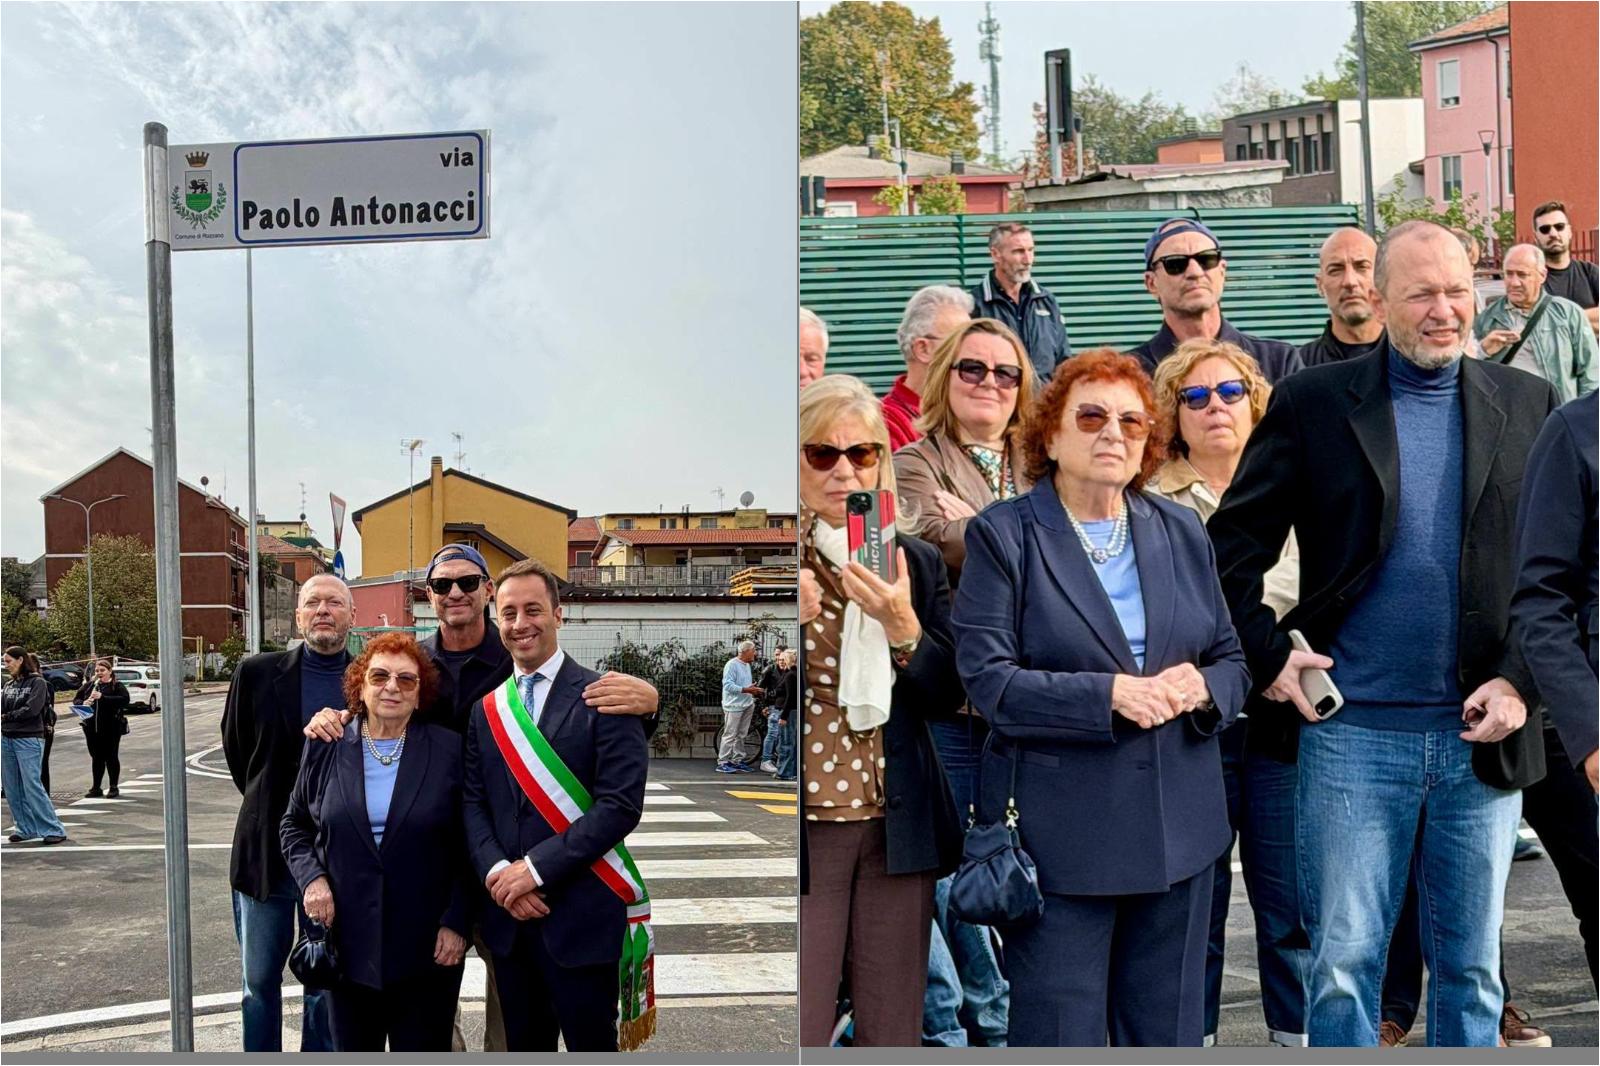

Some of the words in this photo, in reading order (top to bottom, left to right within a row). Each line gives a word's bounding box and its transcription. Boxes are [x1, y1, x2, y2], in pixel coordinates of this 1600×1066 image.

[440, 147, 474, 168] via
[242, 199, 320, 230] Paolo
[329, 191, 475, 227] Antonacci
